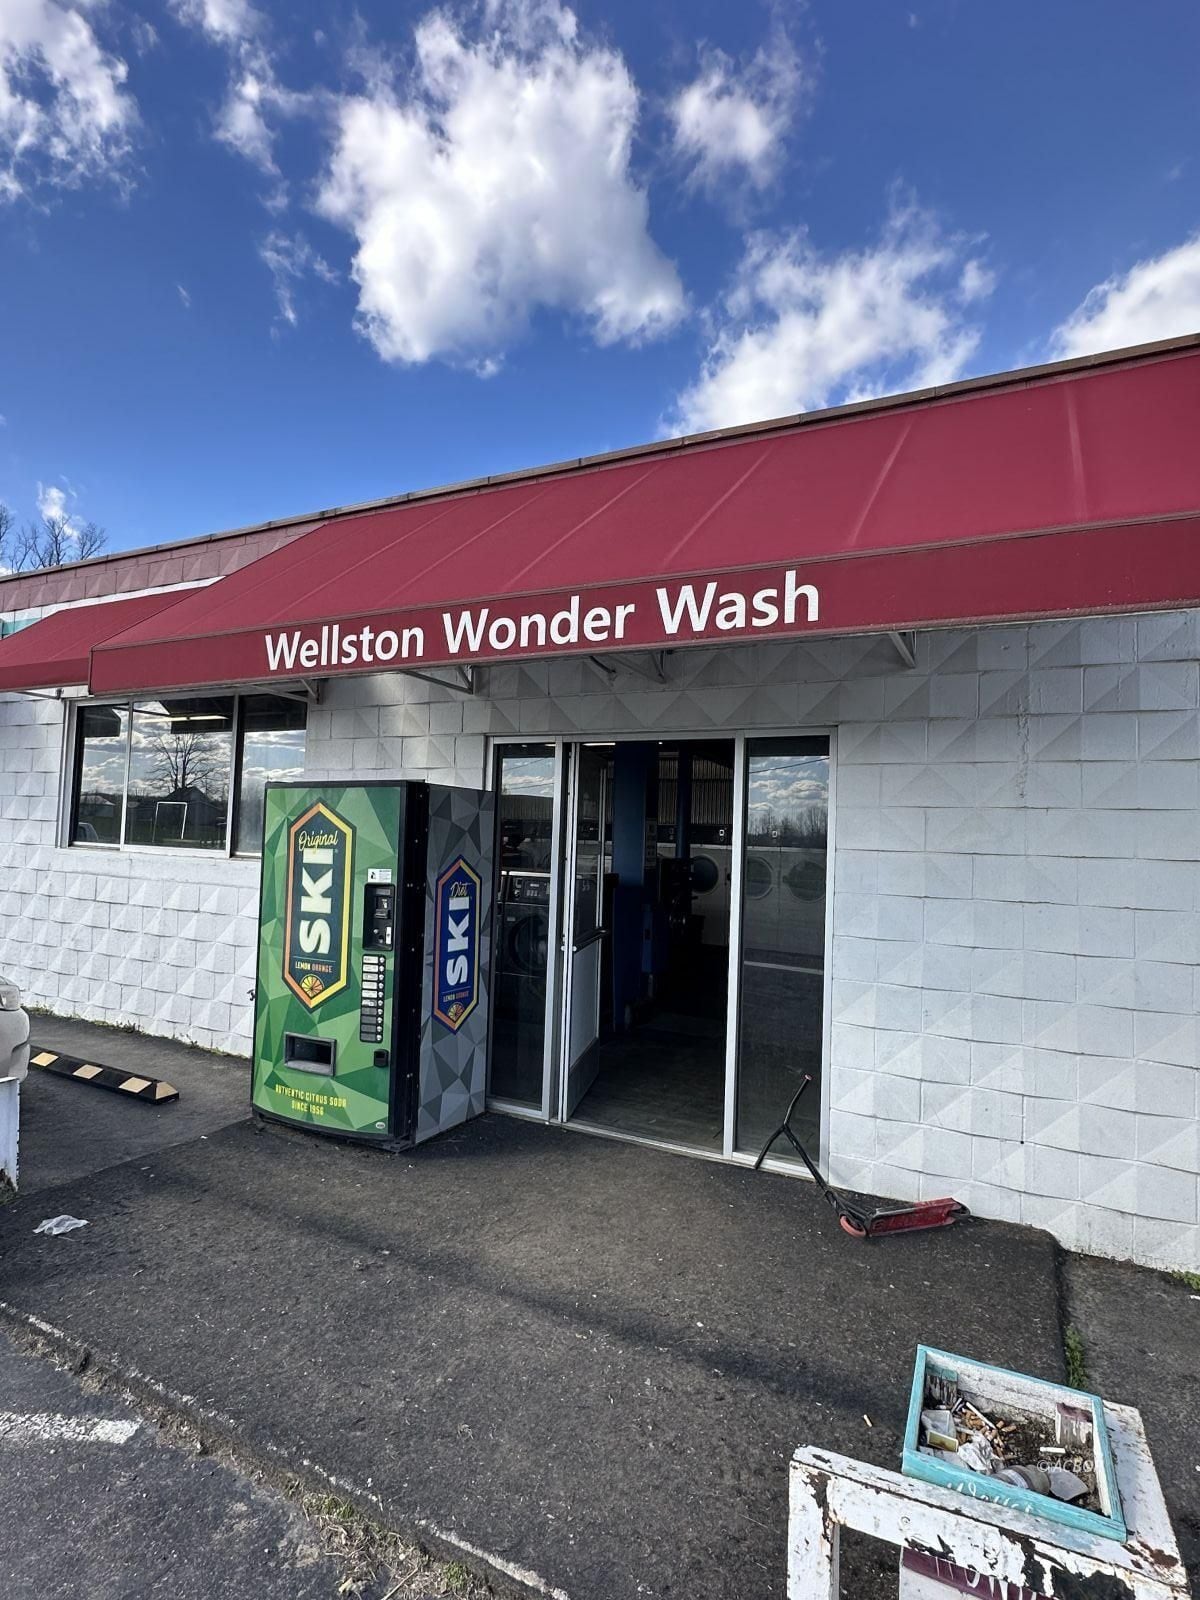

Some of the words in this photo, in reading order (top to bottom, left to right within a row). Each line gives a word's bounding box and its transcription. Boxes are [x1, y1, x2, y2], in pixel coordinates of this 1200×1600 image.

[264, 623, 425, 671] Wellston
[442, 595, 635, 655] Wonder
[656, 570, 820, 635] Wash
[298, 829, 339, 852] Original
[450, 881, 472, 897] Diet
[299, 848, 334, 955] SKI
[446, 897, 470, 986] SKI
[295, 960, 311, 971] LEMON
[305, 1091, 328, 1105] CITRUS
